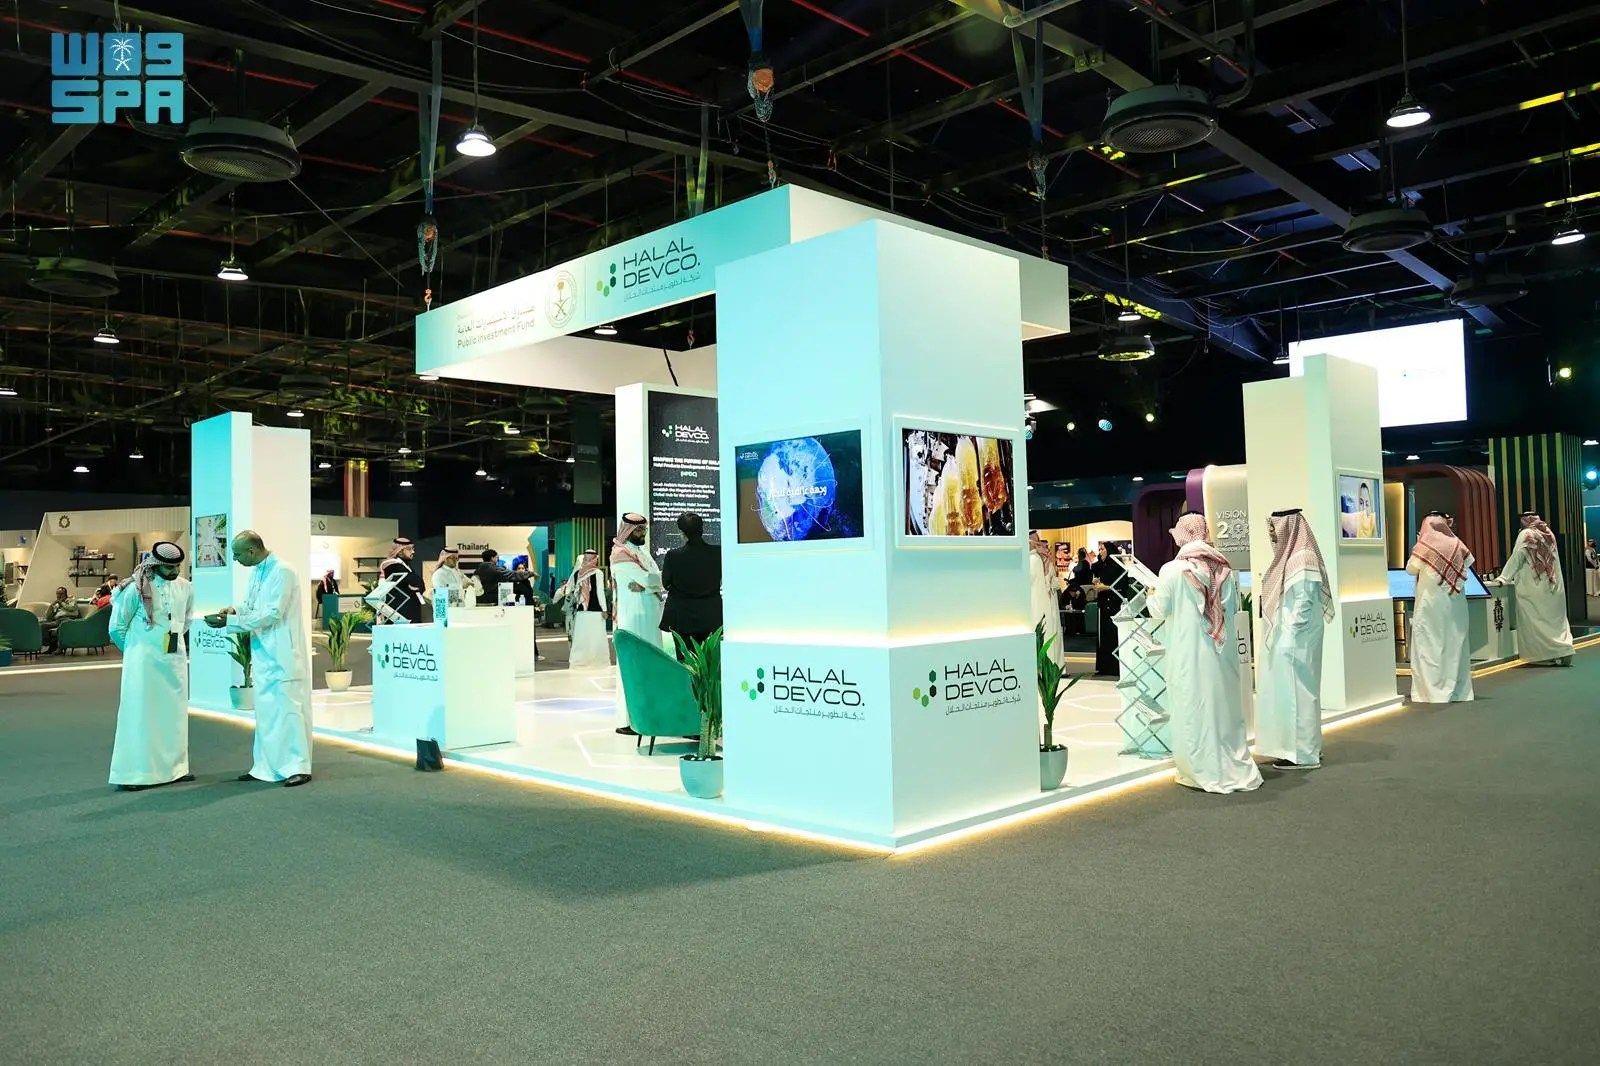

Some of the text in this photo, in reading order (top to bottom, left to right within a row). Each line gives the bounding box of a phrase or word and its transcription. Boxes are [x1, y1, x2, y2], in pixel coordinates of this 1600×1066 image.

[623, 237, 694, 270] HALAL
[623, 253, 700, 288] DEVCO.
[457, 336, 477, 349] Public
[516, 319, 535, 333] Fund
[674, 424, 707, 433] HALAL
[1216, 510, 1247, 519] VISION
[456, 542, 489, 551] Thailand
[1360, 610, 1386, 622] HALAL
[392, 642, 434, 656] HALAL
[393, 656, 438, 672] DEVCO.
[945, 658, 1014, 680] HALAL
[773, 666, 857, 686] HALAL
[773, 685, 865, 706] DEVCO.
[945, 676, 1021, 700] DEVCO.
